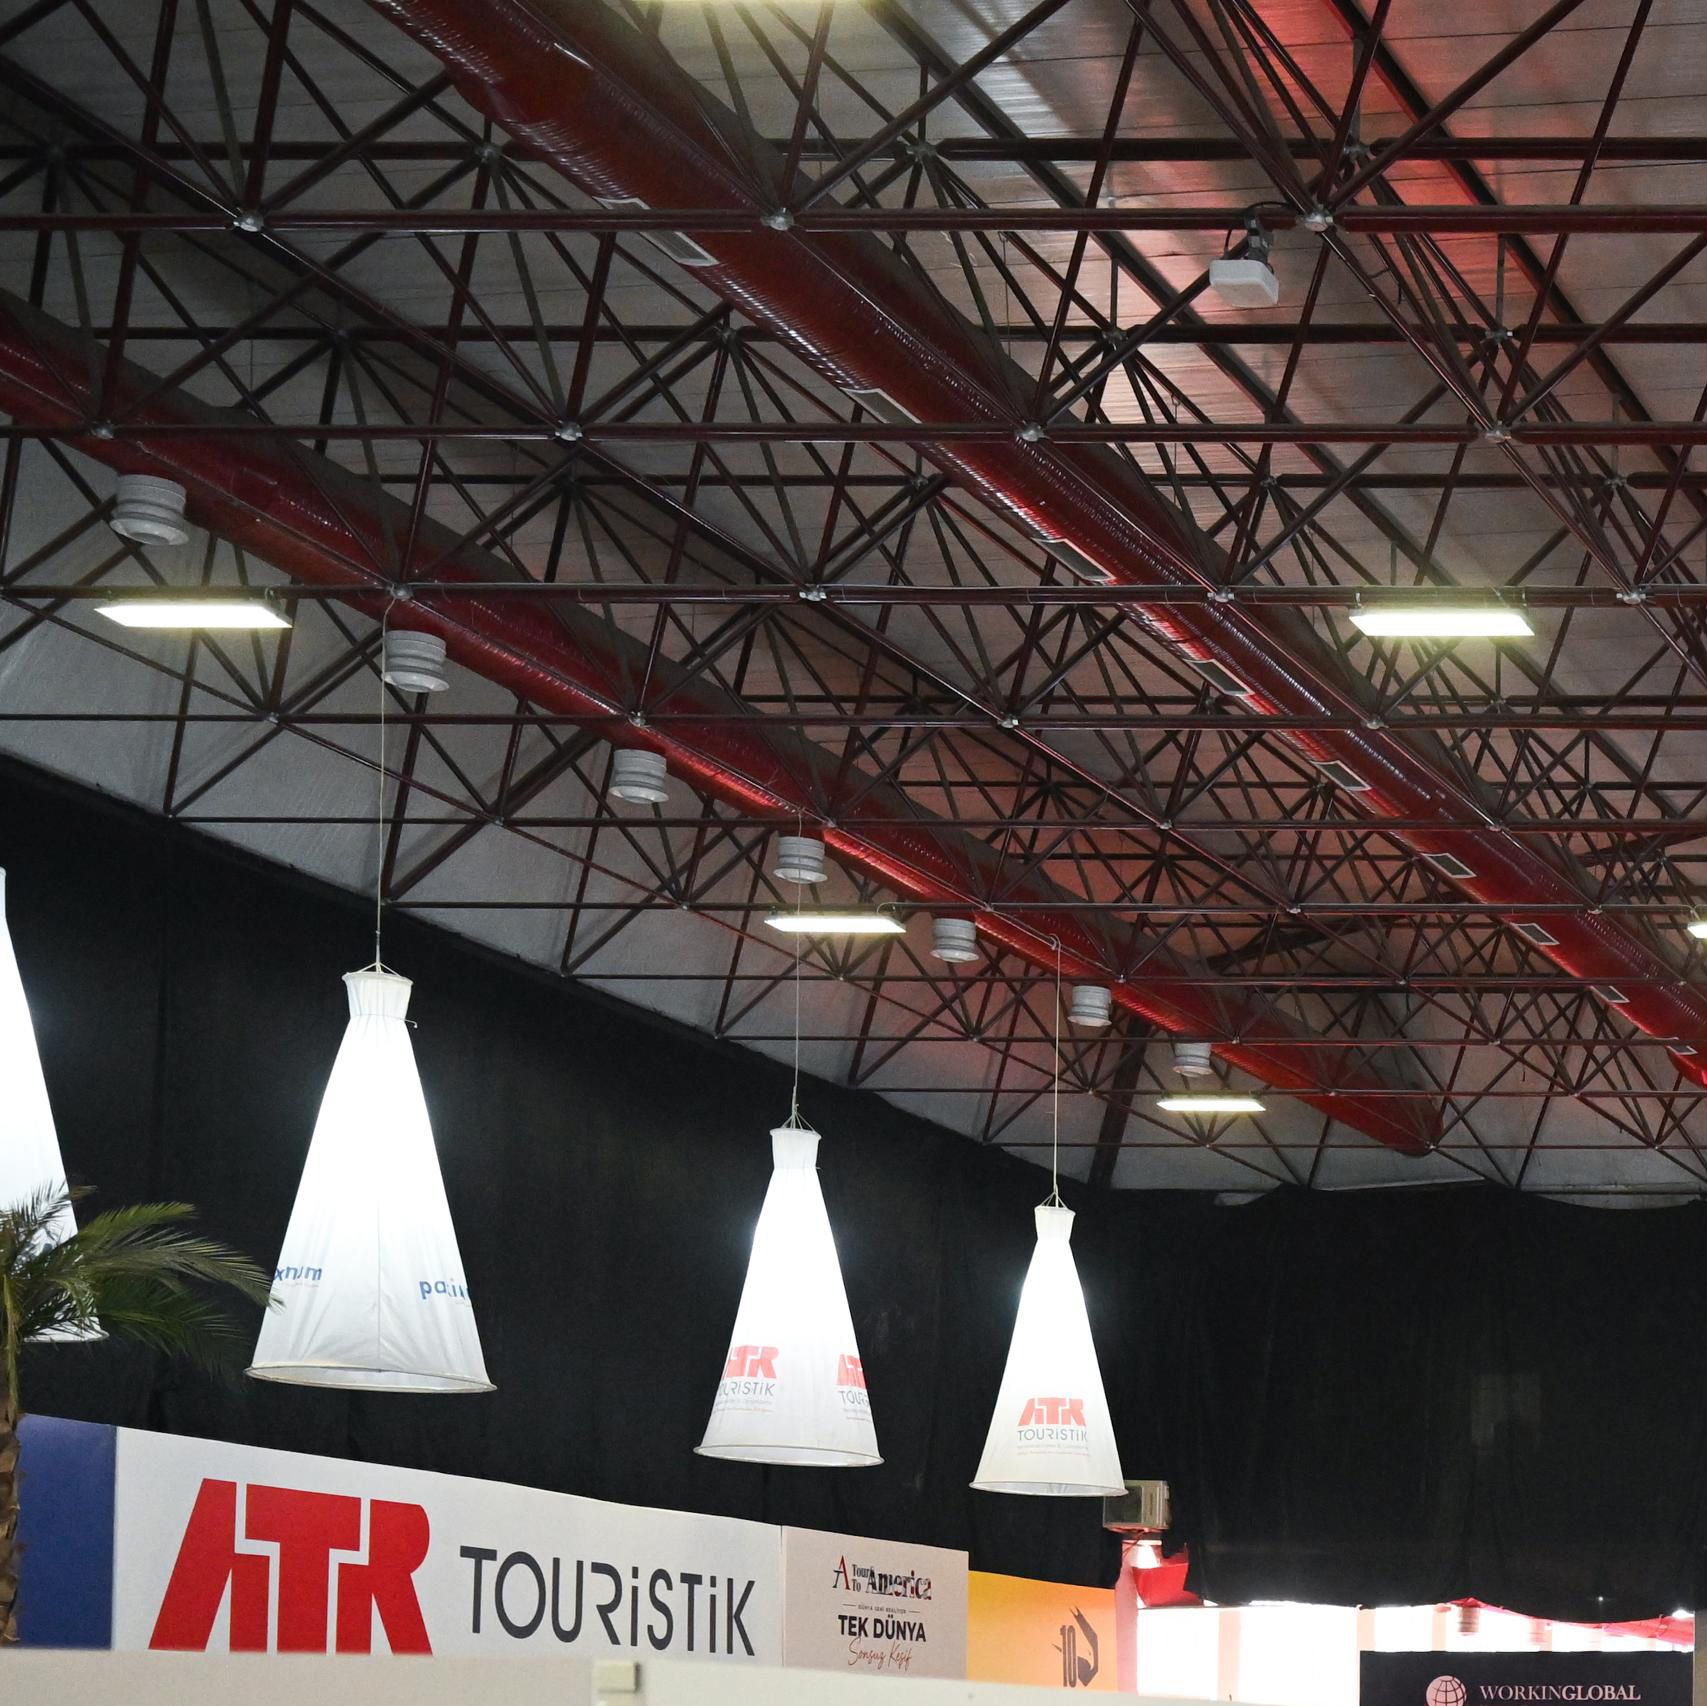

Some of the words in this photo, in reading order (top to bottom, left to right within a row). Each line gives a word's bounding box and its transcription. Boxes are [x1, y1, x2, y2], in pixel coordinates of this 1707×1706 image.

[148, 1478, 433, 1655] ATR
[838, 1614, 868, 1638] TEK
[873, 1614, 927, 1642] DÜNYA
[1480, 1684, 1641, 1702] WORKINGLOBAL
